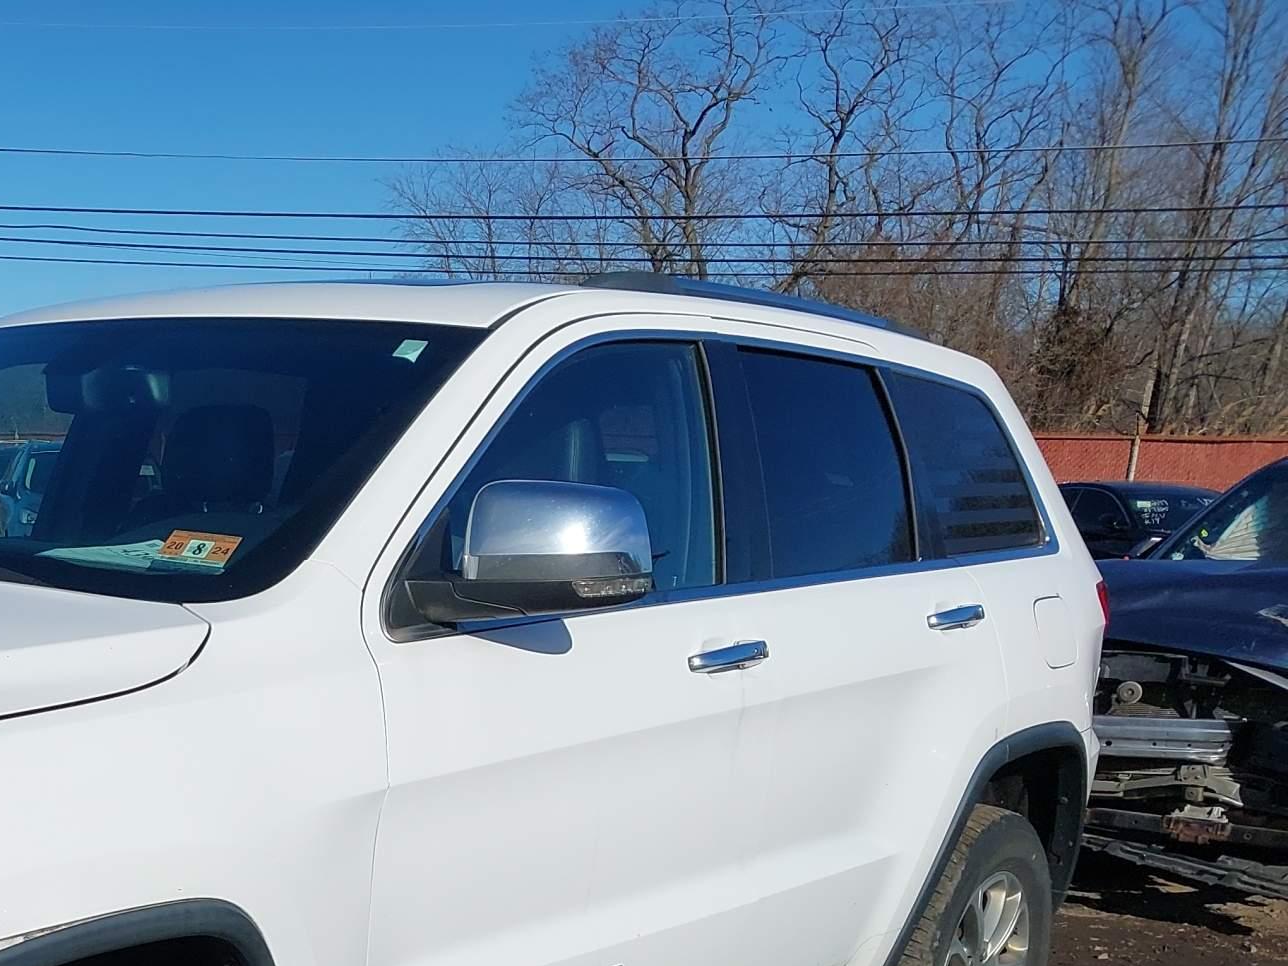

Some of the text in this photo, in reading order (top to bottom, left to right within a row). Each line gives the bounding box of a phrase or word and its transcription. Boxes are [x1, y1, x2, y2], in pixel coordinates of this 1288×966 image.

[167, 542, 230, 555] 20 8 24
